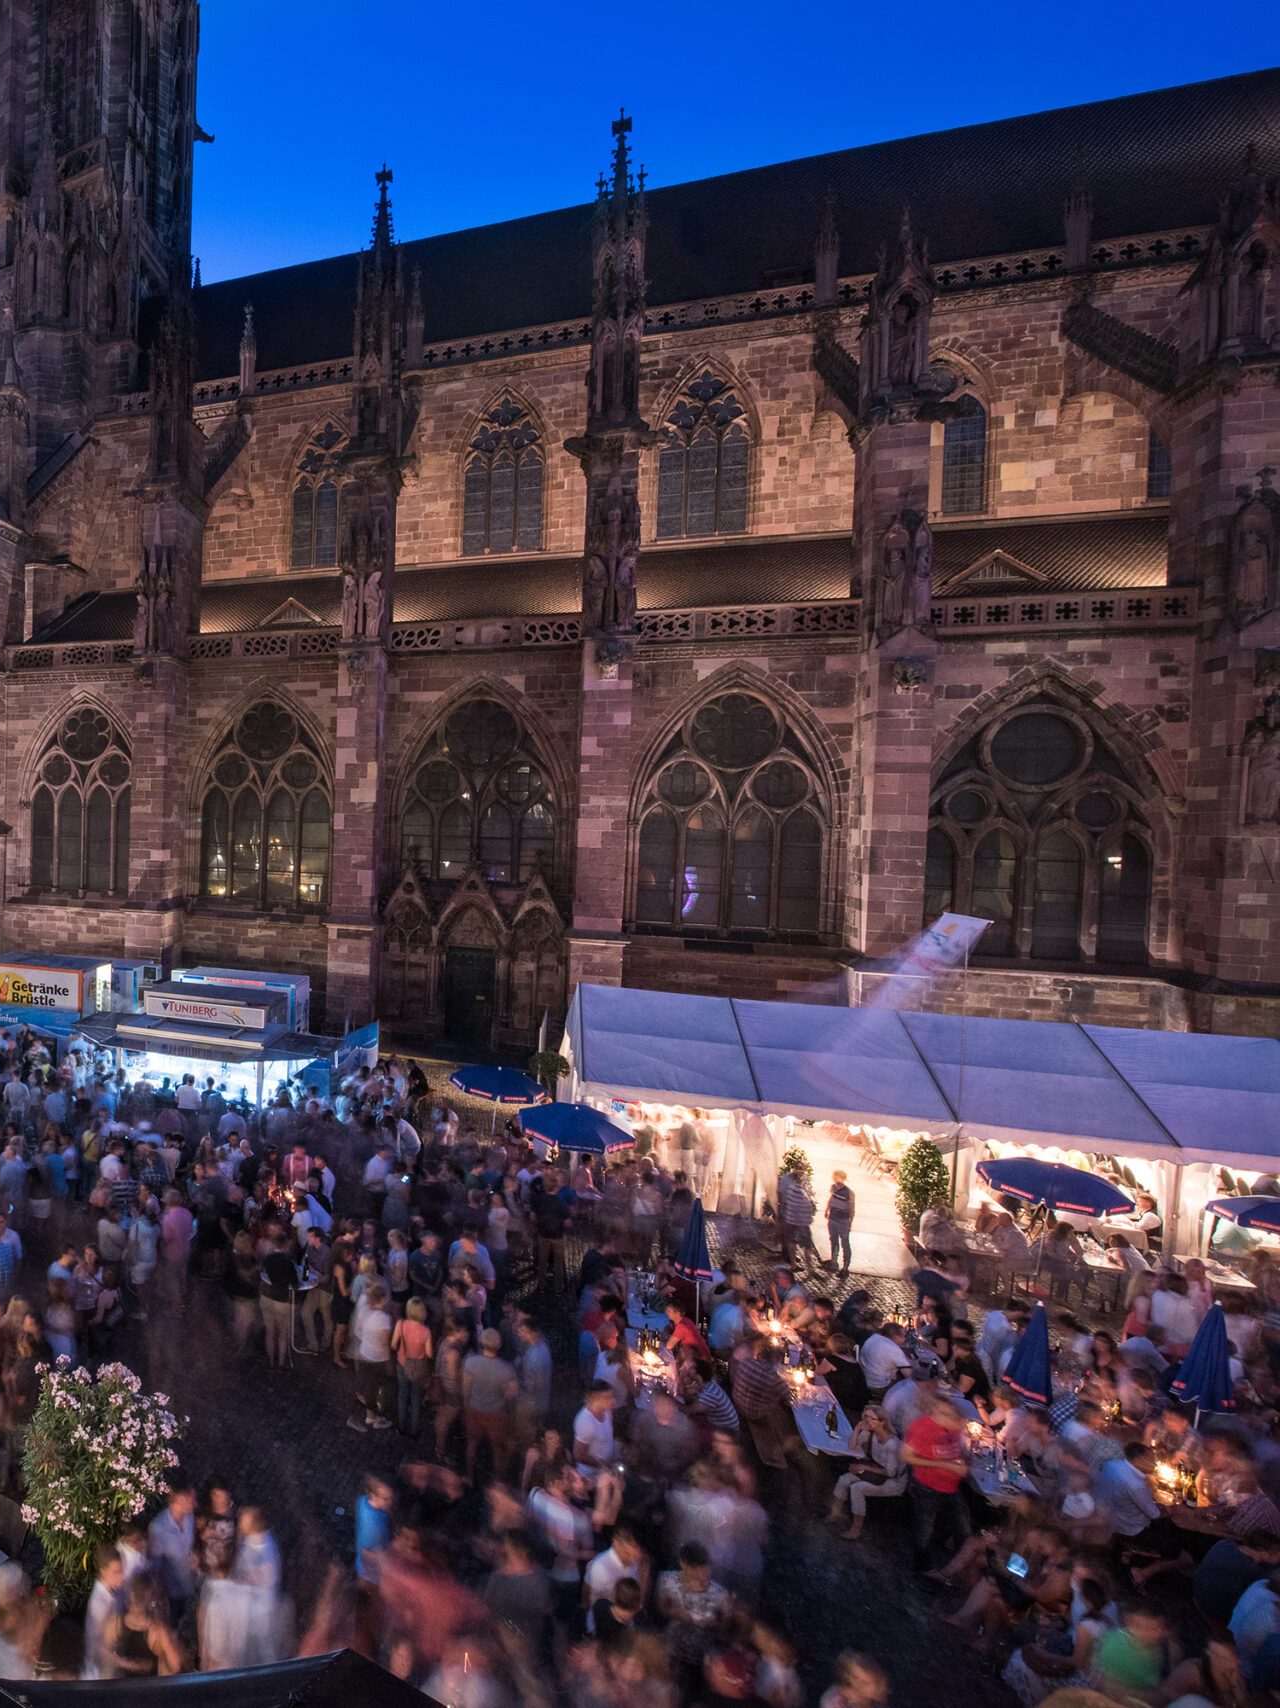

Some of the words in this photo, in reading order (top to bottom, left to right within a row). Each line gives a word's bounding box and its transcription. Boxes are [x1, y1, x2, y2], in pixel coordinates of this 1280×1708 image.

[12, 980, 69, 996] Getränke
[12, 992, 56, 1006] Brüstle
[168, 1001, 218, 1018] TUNIBERG
